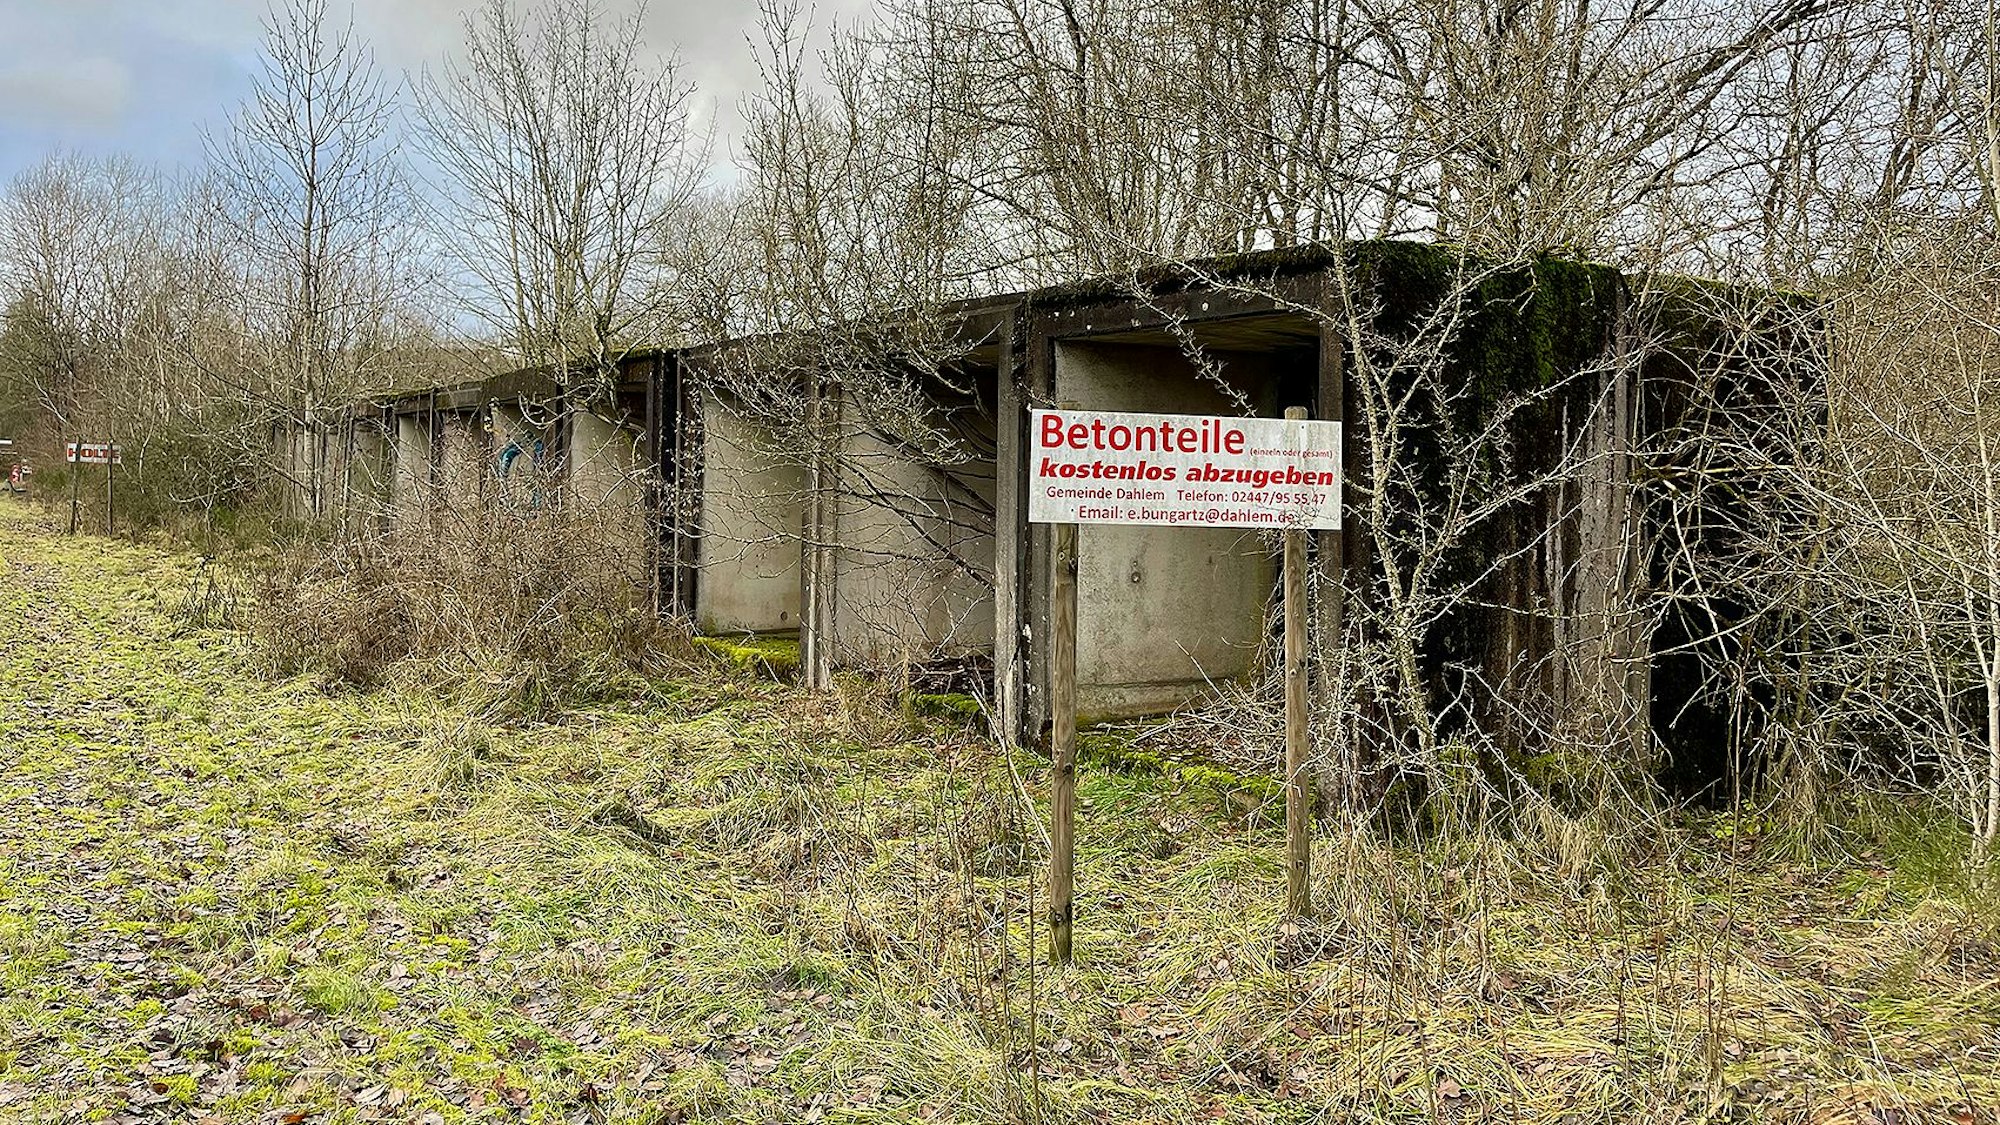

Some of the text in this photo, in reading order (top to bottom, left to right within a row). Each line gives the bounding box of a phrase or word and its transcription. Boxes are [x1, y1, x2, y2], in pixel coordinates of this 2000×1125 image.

[1041, 414, 1245, 455] Betonteile
[1283, 449, 1300, 457] oder
[1039, 457, 1333, 489] kostenlos abzugeben
[1046, 486, 1113, 499] Gemeinde
[1116, 488, 1165, 500] Dahlem
[1177, 490, 1228, 502] Telefon:
[1231, 491, 1290, 506] 02447/95
[1079, 505, 1123, 519] Email:
